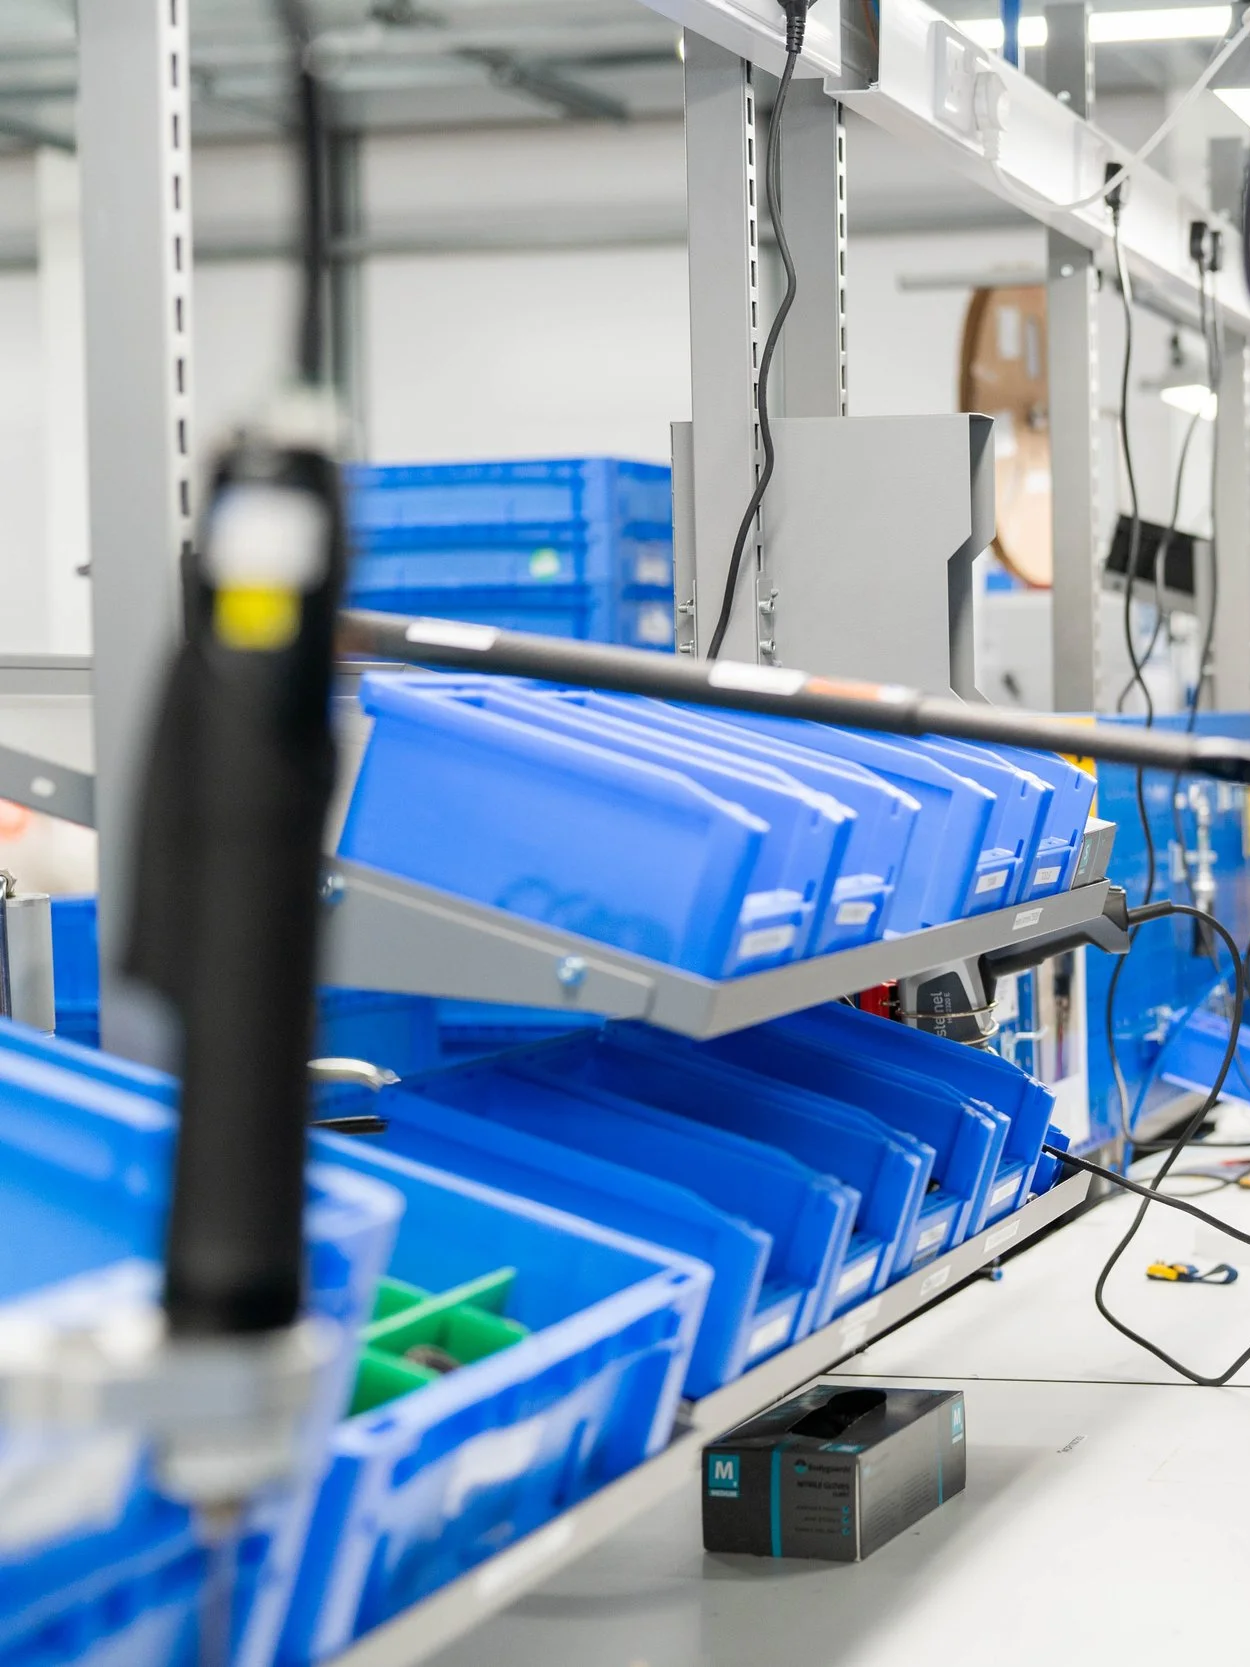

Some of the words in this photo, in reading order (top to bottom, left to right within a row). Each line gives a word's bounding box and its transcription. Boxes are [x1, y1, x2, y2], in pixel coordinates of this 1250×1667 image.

[930, 991, 946, 1036] stenel
[953, 1408, 961, 1426] M
[714, 1460, 734, 1480] M
